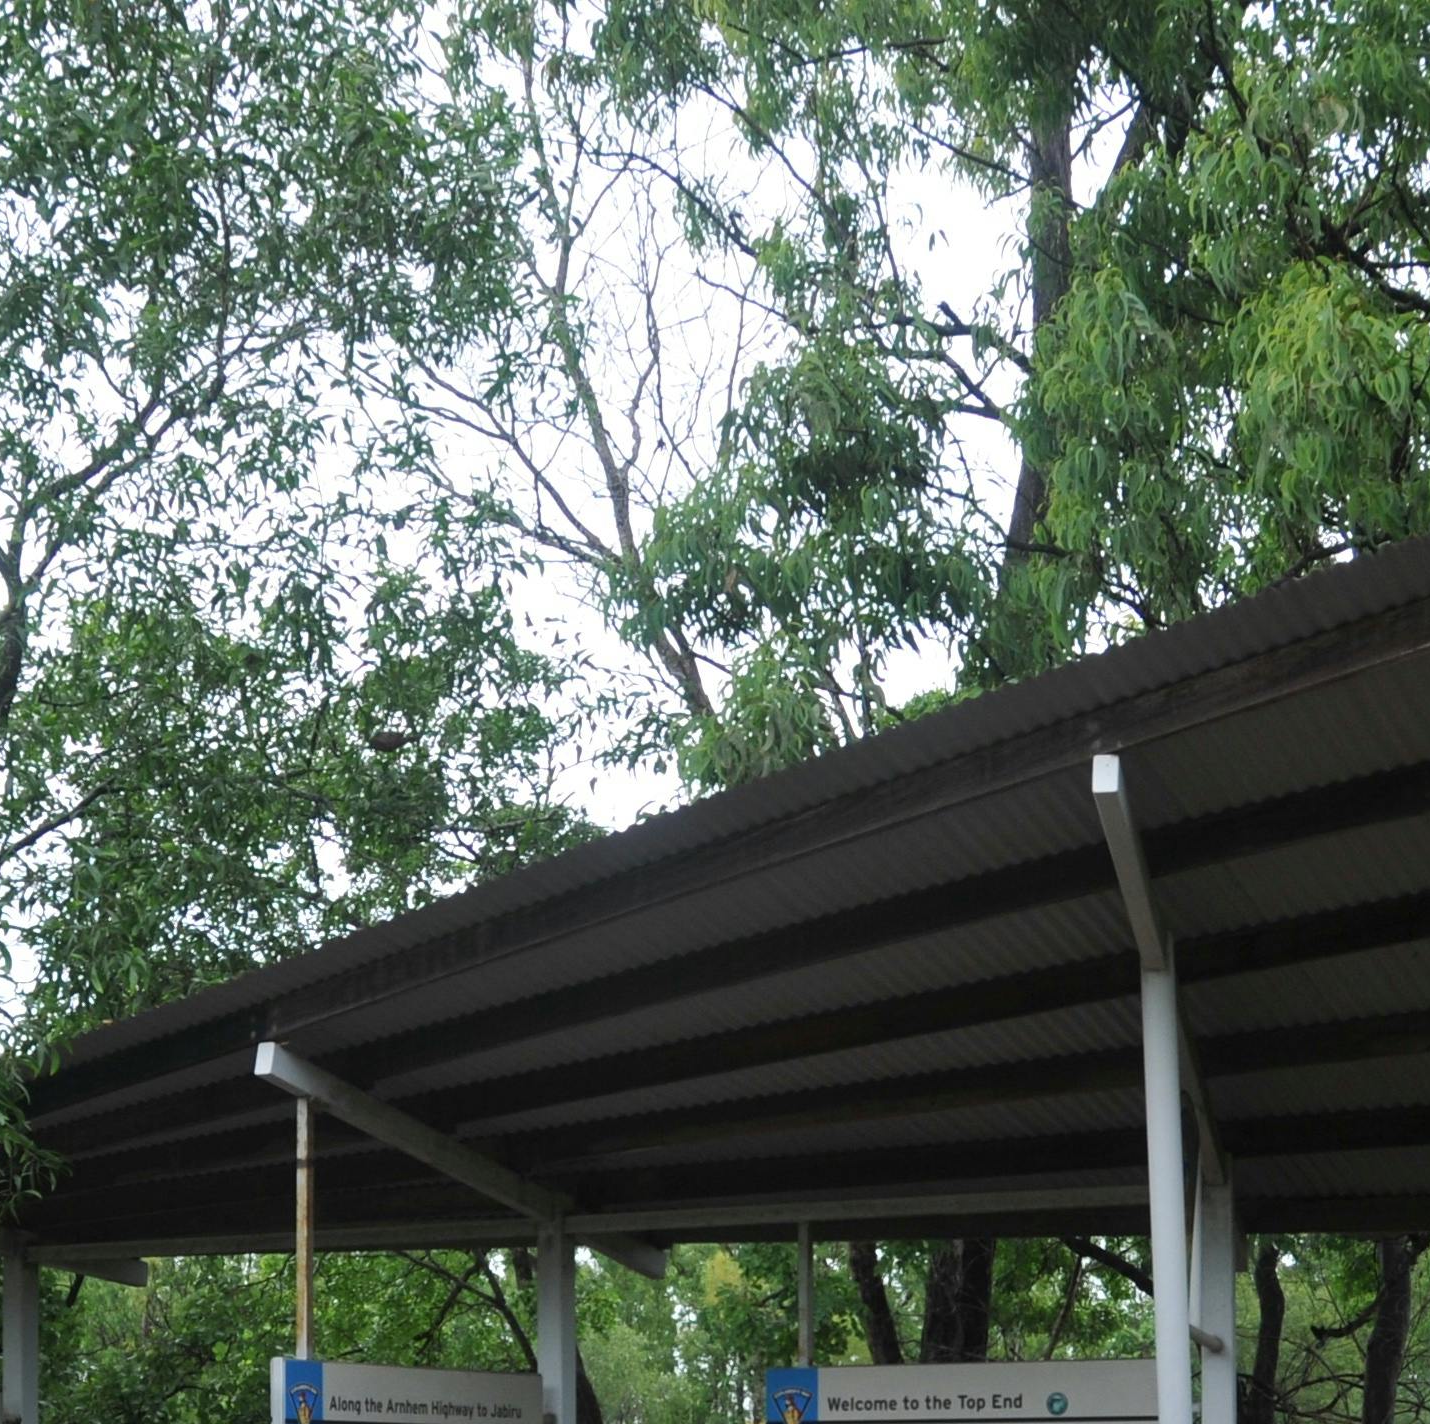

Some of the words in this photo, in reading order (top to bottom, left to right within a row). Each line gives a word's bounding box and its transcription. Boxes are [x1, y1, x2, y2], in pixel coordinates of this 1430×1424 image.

[329, 1396, 361, 1415] Along
[365, 1397, 383, 1413] the
[386, 1398, 428, 1415] Arnhem
[431, 1401, 474, 1420] Highway
[477, 1403, 488, 1417] to
[491, 1403, 522, 1419] Jabiru
[827, 1396, 897, 1411] Welcome
[903, 1396, 919, 1410] to
[925, 1395, 951, 1410] the
[957, 1394, 986, 1411] Top
[992, 1393, 1023, 1409] End
